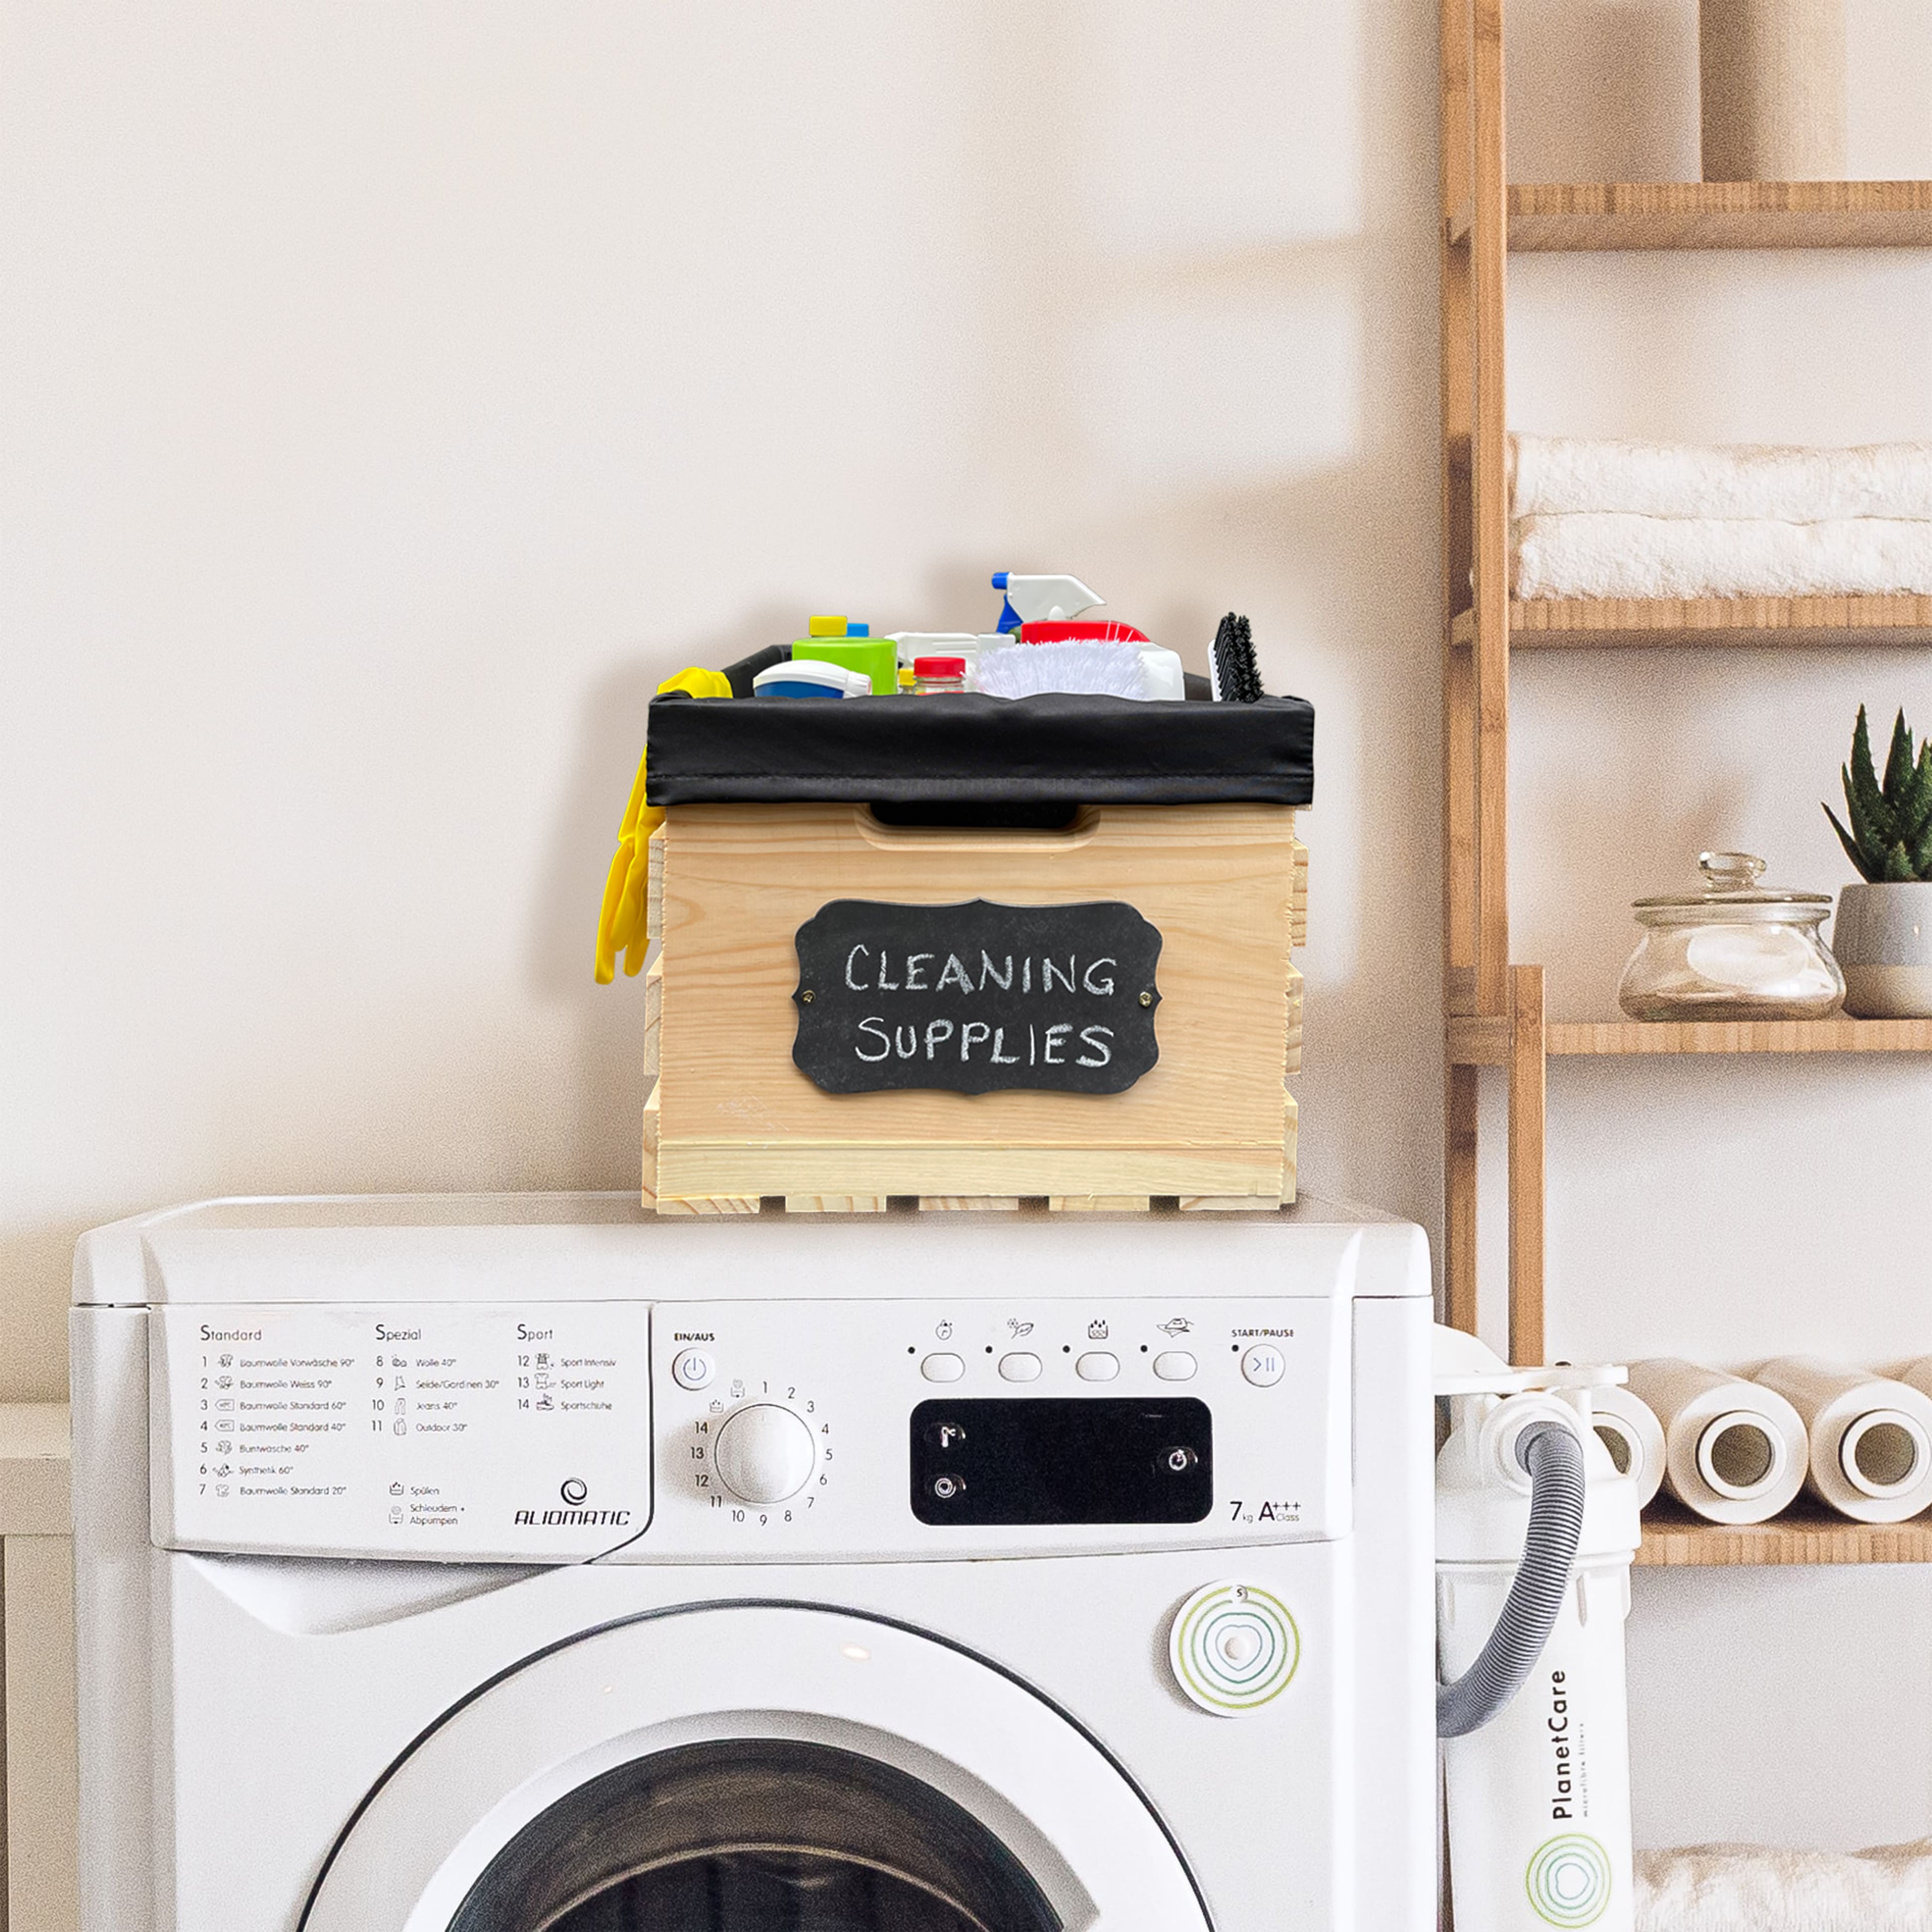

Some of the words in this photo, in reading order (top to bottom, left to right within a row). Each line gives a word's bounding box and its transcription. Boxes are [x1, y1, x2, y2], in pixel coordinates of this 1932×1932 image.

[846, 944, 1116, 995] CLEANING
[855, 1017, 1113, 1067] SUPPLIES
[201, 1325, 261, 1341] Standard
[376, 1324, 421, 1342] Spezial
[517, 1324, 552, 1342] Sport
[674, 1333, 715, 1341] EIN/AUS
[1232, 1329, 1294, 1337] START/PAUSE
[203, 1356, 206, 1367] 1
[376, 1355, 383, 1366] 8
[518, 1355, 529, 1366] 12
[201, 1378, 208, 1389] 2
[376, 1378, 383, 1388] 9
[518, 1377, 529, 1388] 13
[763, 1381, 767, 1393] 1
[788, 1387, 795, 1399] 2
[201, 1399, 208, 1410] 3
[372, 1399, 384, 1411] 10
[518, 1399, 529, 1409] 14
[807, 1401, 814, 1413] 3
[201, 1421, 207, 1431] 4
[372, 1420, 381, 1431] 11
[695, 1422, 707, 1434] 14
[822, 1423, 829, 1434] 4
[201, 1442, 207, 1453] 5
[691, 1446, 704, 1459] 13
[825, 1448, 832, 1461] 5
[200, 1464, 207, 1474] 6
[695, 1475, 709, 1487] 12
[820, 1474, 827, 1485] 6
[200, 1484, 206, 1495] 7
[710, 1495, 721, 1507] 11
[808, 1497, 814, 1508] 7
[515, 1510, 630, 1525] ALIOMATIC
[732, 1510, 745, 1522] 10
[760, 1514, 767, 1526] 9
[784, 1510, 792, 1521] 8
[1548, 1671, 1572, 1819] PlanetCare
